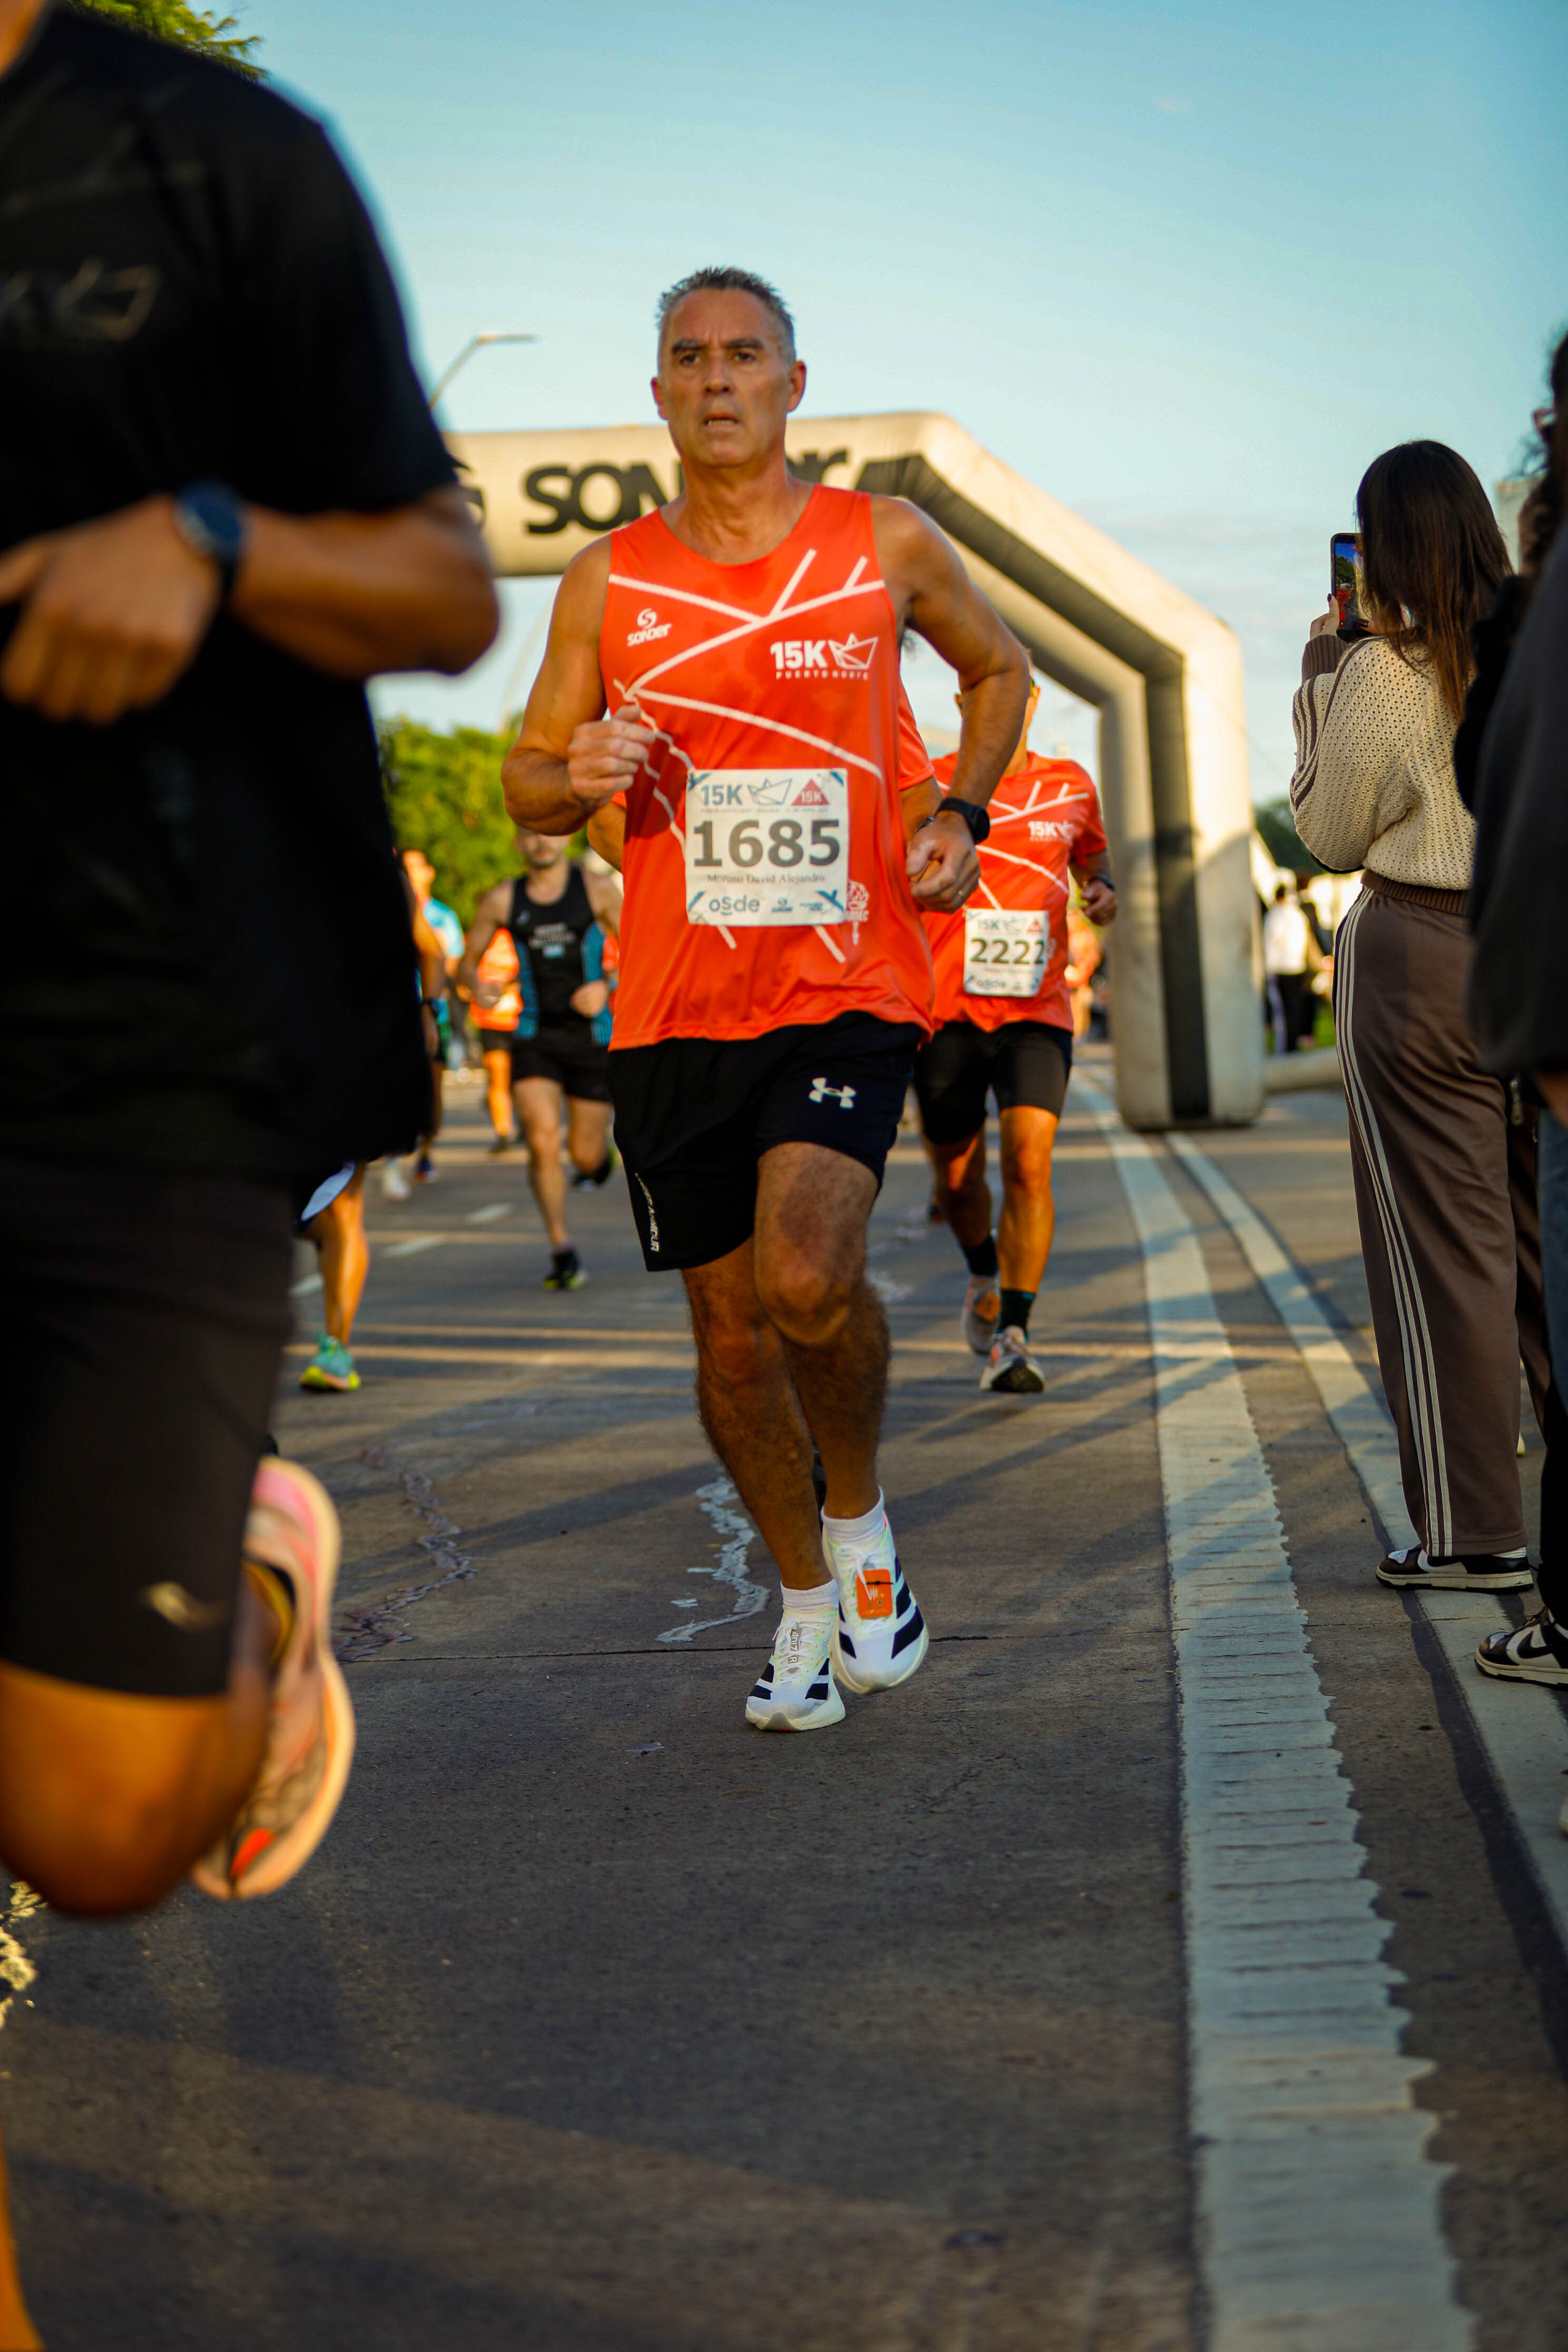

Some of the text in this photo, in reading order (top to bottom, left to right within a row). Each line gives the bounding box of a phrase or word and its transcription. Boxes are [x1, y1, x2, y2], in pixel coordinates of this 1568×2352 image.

[770, 640, 828, 670] 15K
[776, 670, 869, 681] PUERTO NORTE
[700, 784, 742, 805] 15K
[801, 791, 822, 804] 15K
[1028, 821, 1057, 838] 15K
[693, 819, 840, 868] 1685
[746, 873, 776, 883] David
[779, 873, 825, 885] Alejandro
[709, 895, 760, 913] osde
